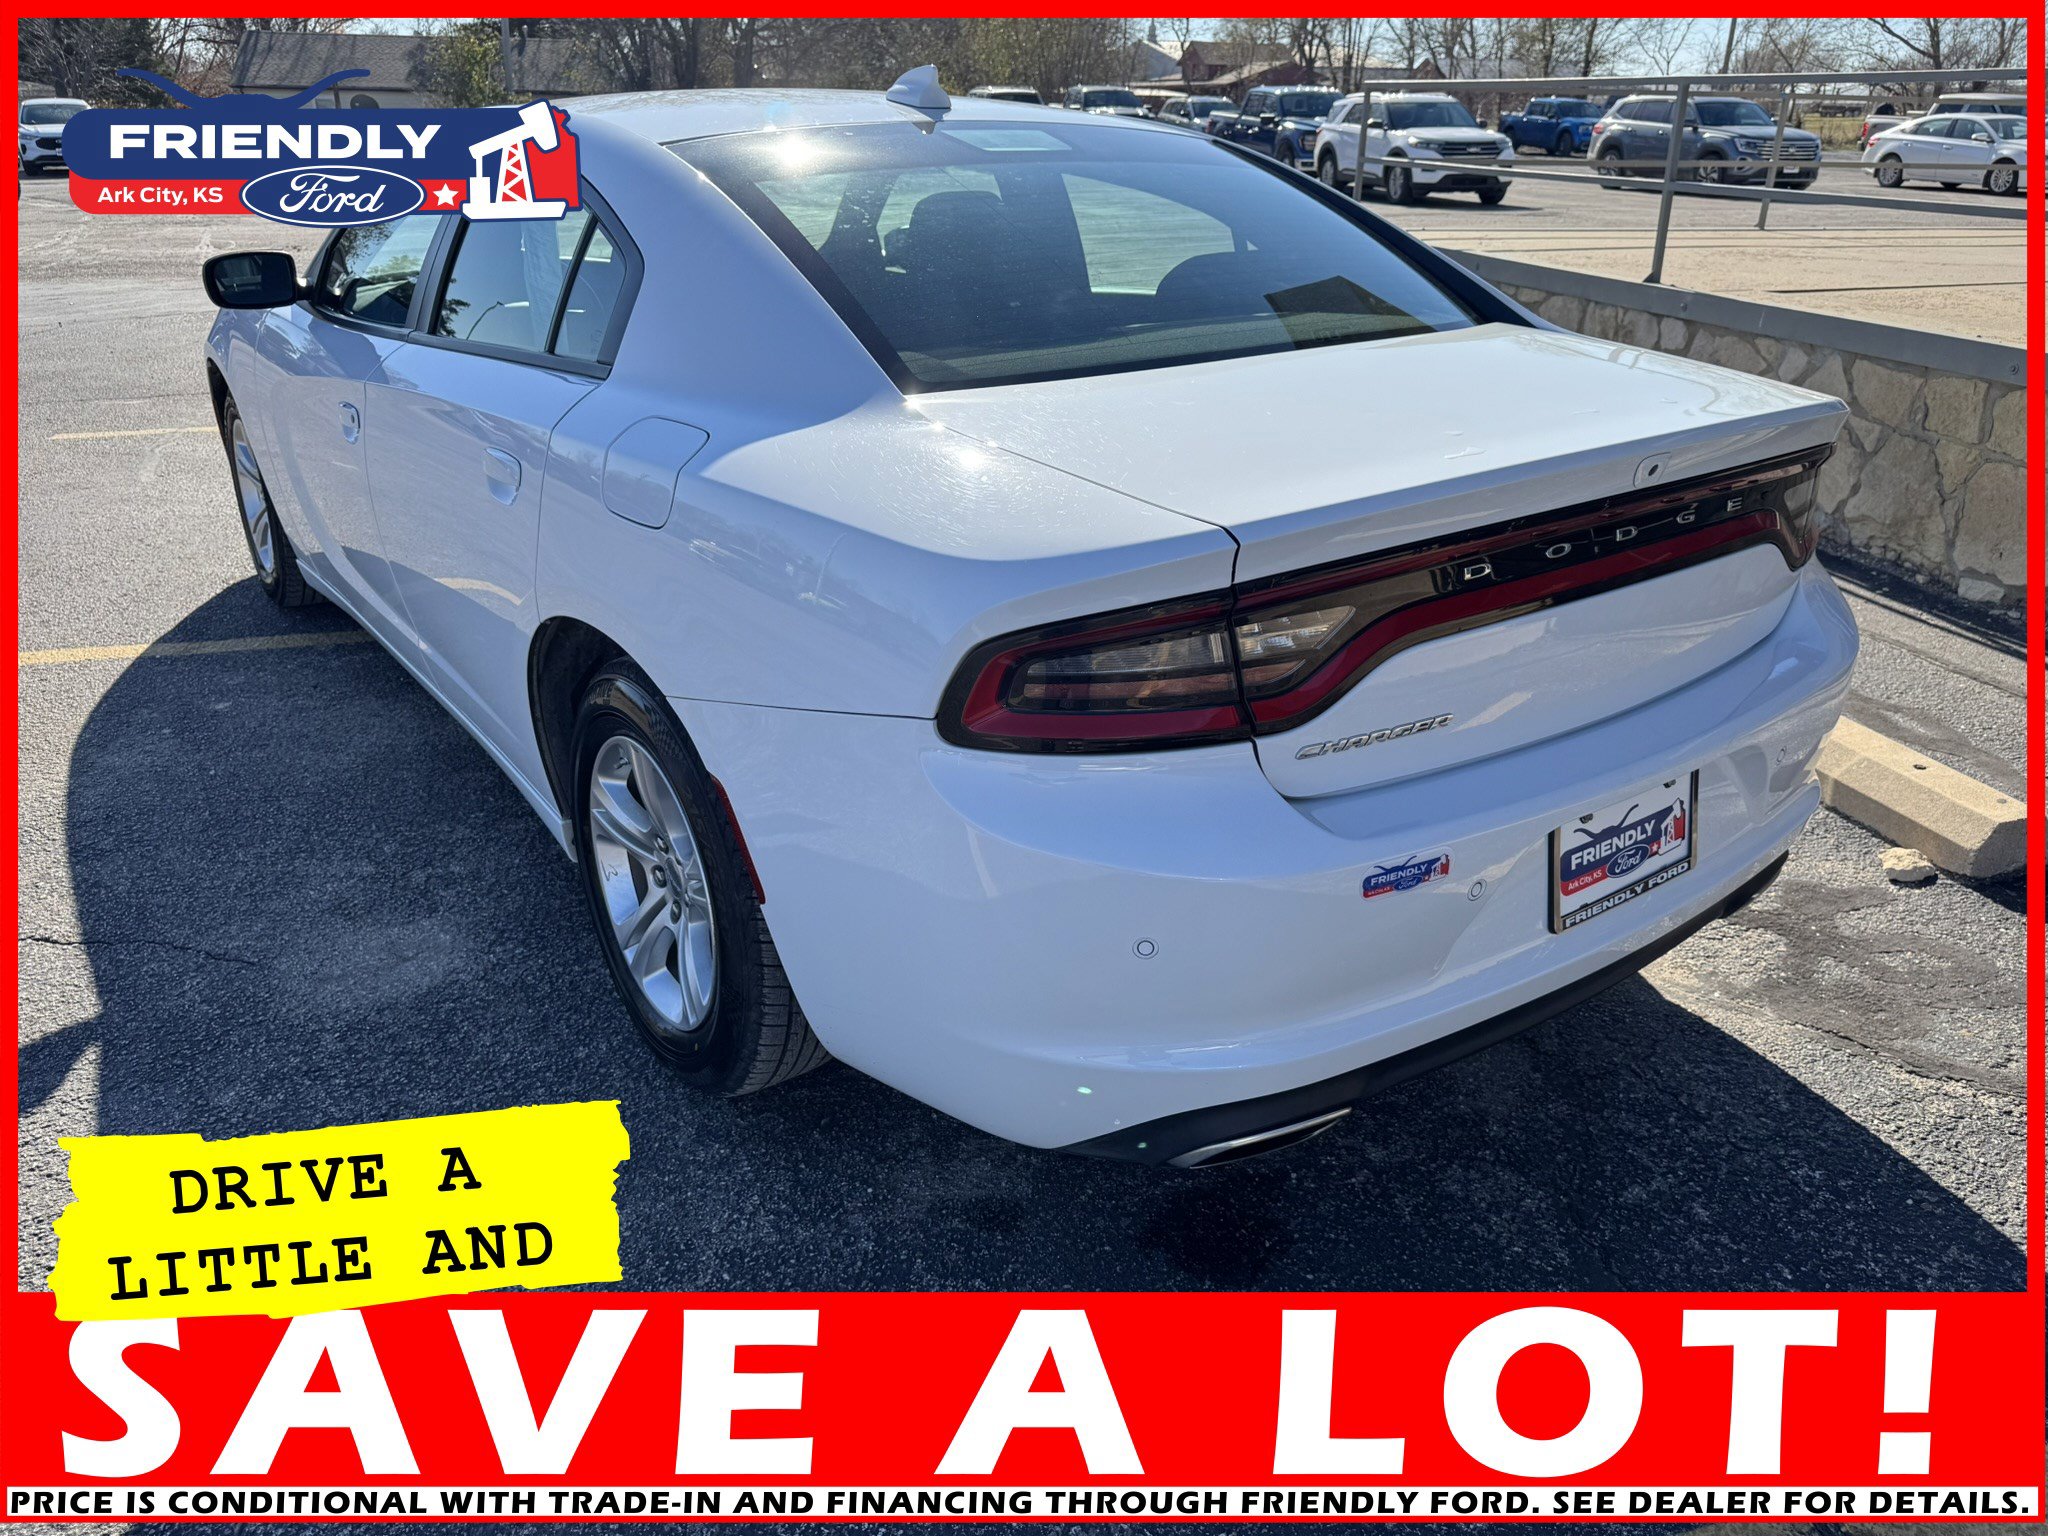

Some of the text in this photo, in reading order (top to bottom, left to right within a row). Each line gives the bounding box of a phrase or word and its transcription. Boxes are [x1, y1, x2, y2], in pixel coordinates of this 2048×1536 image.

[1463, 497, 1743, 581] DODGE
[1295, 712, 1454, 761] CHARGER
[1571, 819, 1657, 871] FRIENDLY
[1614, 849, 1642, 874] Ford
[1370, 863, 1428, 886] FRIENDLY
[1565, 862, 1689, 928] FRIENDLY FORD
[1568, 880, 1579, 891] Ark
[1593, 869, 1603, 879] KS
